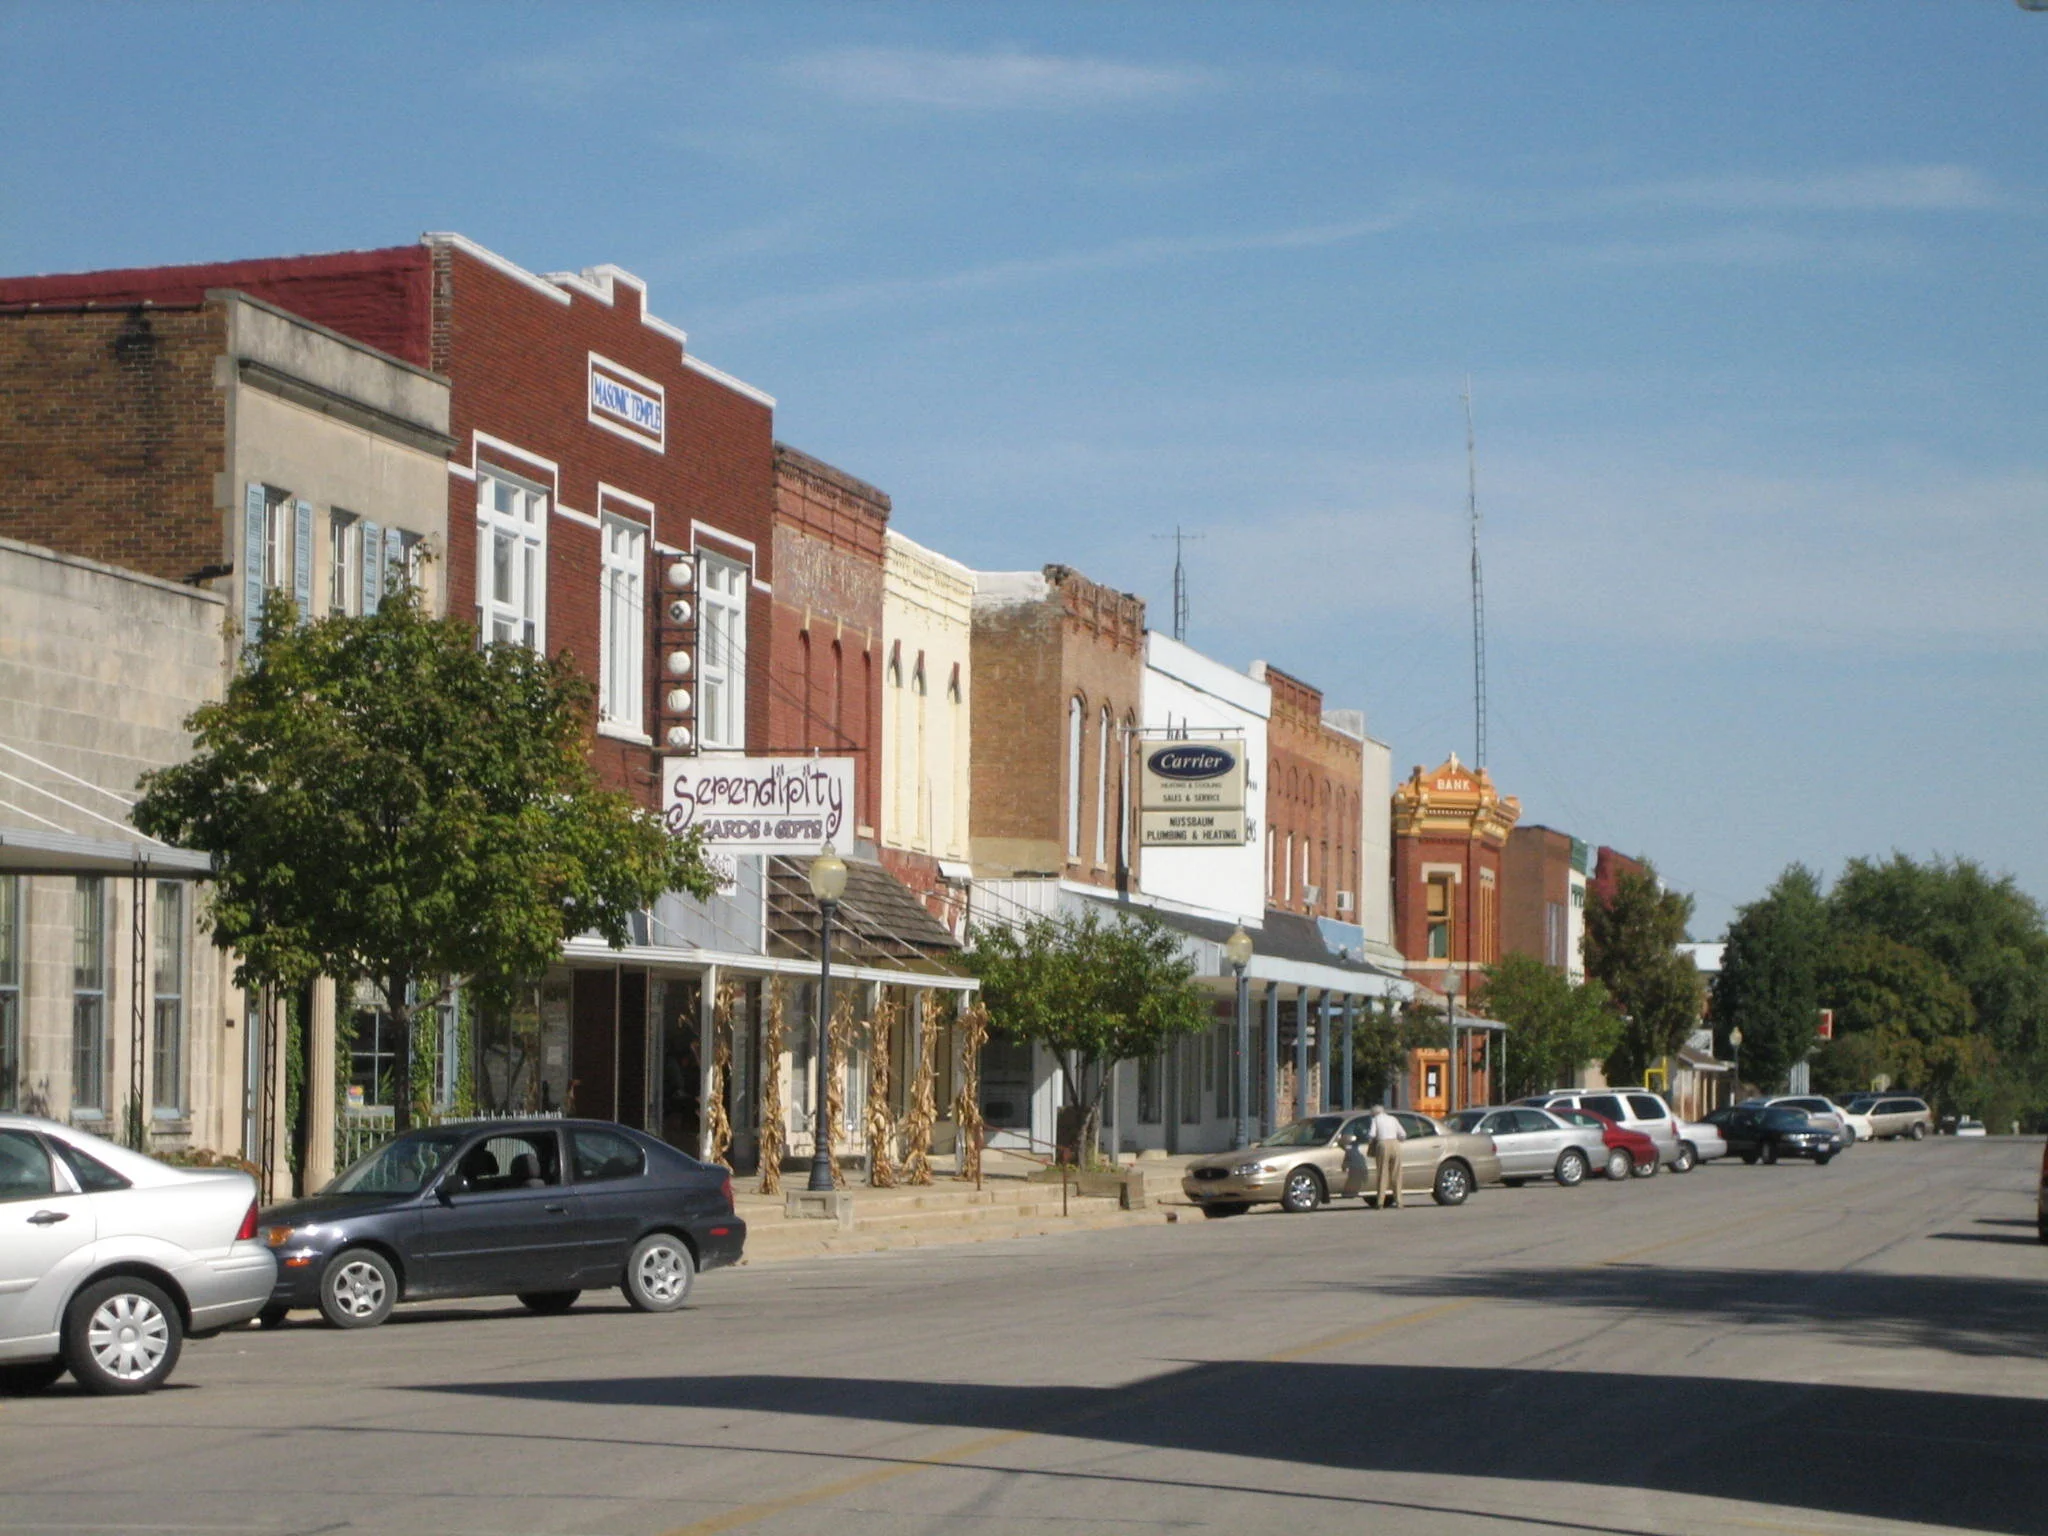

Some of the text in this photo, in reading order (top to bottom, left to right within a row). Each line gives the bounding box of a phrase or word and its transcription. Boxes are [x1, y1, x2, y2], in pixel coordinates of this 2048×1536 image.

[630, 393, 661, 430] TEMPLE
[1160, 753, 1223, 769] Carrier
[1437, 779, 1470, 791] BANK
[666, 763, 843, 839] Serendipity
[1163, 794, 1182, 802] SALES
[1194, 794, 1220, 802] SERVICE
[1169, 816, 1214, 827] NUSSBAUM
[763, 821, 773, 836] &
[774, 820, 823, 839] GIFTS
[1147, 829, 1187, 840] PLUMBING
[1192, 830, 1198, 840] &
[1203, 829, 1237, 840] HEATING
